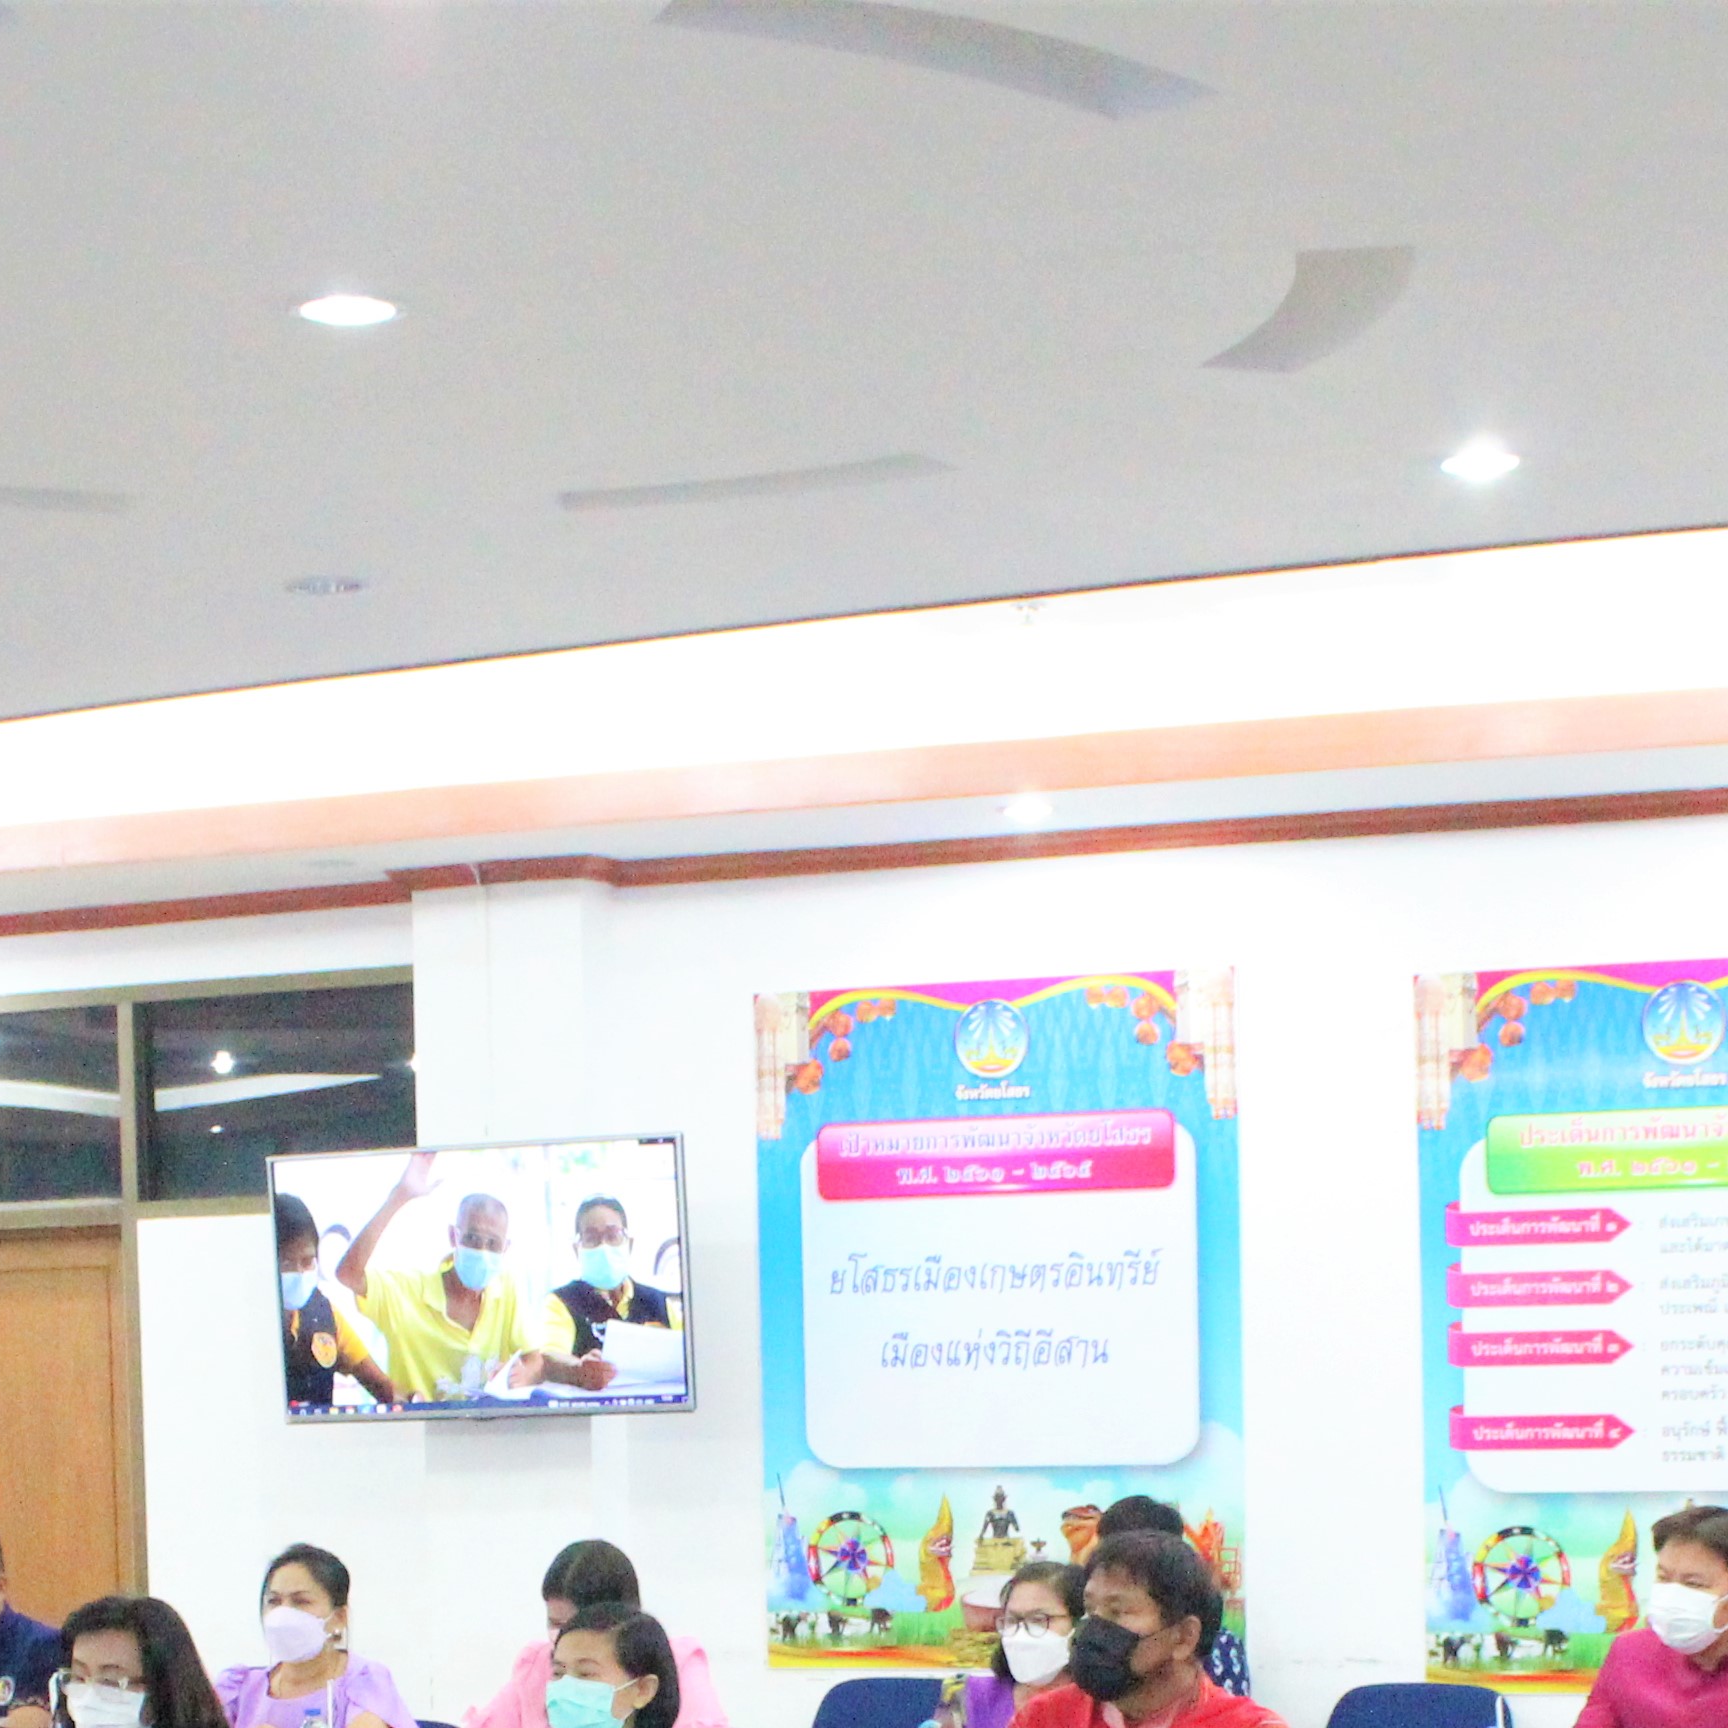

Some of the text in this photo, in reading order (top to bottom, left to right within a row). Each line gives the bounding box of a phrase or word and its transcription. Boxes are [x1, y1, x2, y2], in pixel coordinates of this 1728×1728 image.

[830, 1247, 1163, 1295] ยโสธรเมืองเกษตรอินทรีย์
[881, 1328, 1109, 1371] เมืองแห่งวิถีอีสาน
